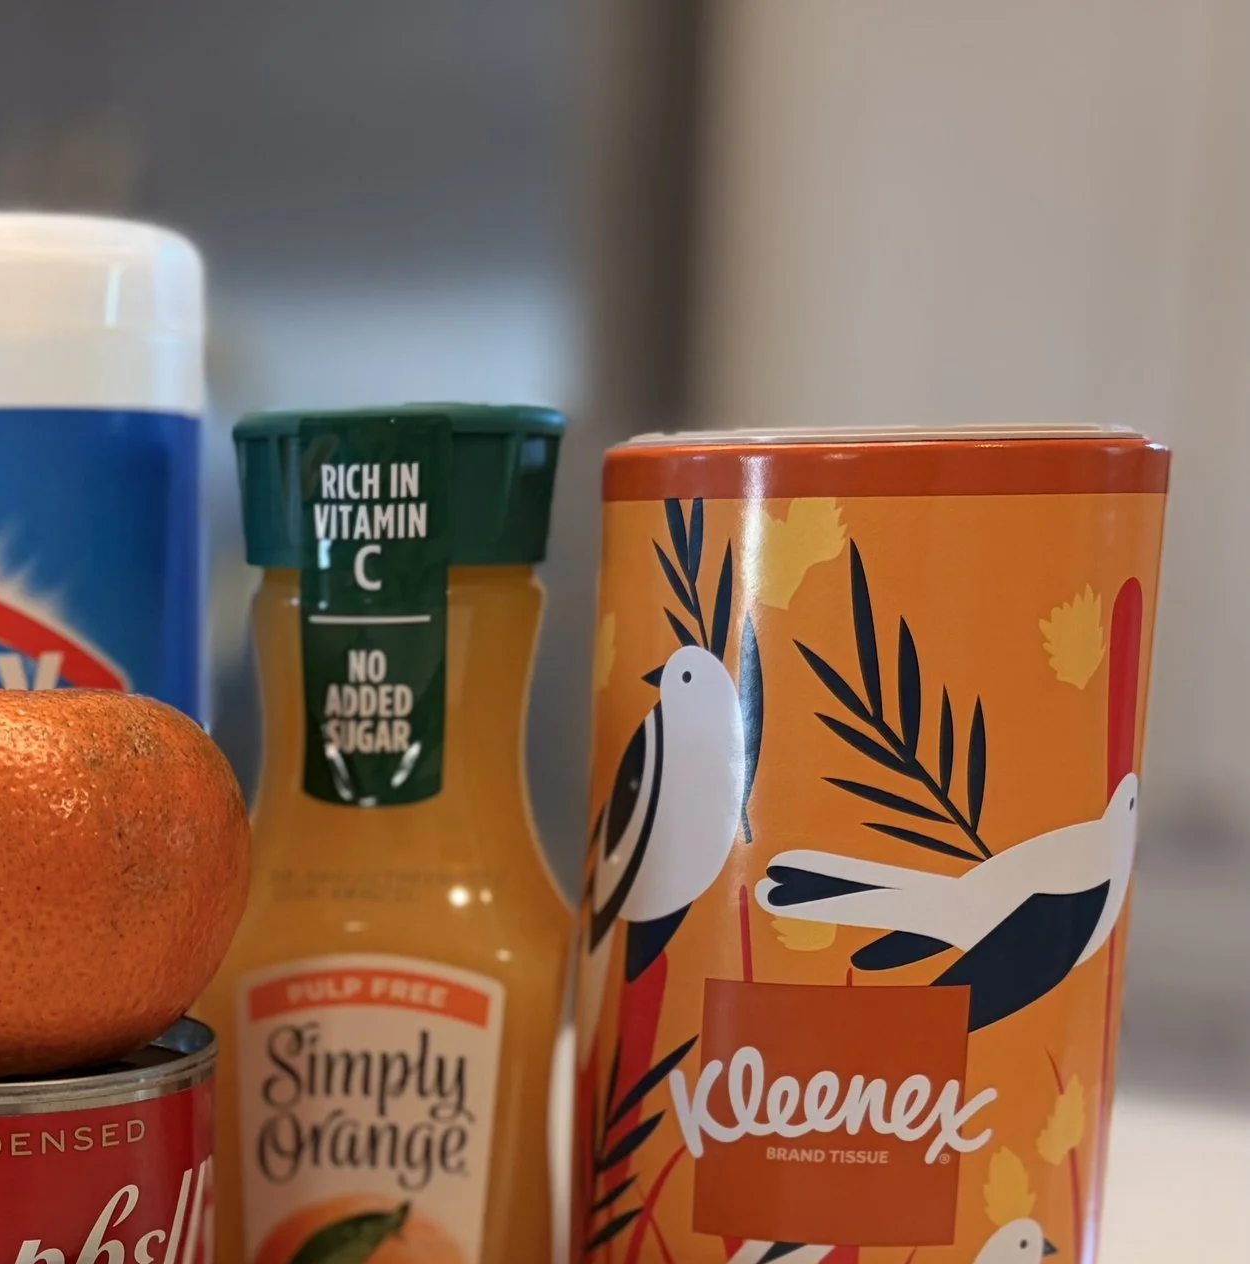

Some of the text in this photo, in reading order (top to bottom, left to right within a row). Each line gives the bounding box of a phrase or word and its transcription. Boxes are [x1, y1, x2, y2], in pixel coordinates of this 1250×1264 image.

[321, 462, 419, 499] RICH IN
[314, 503, 427, 540] VITAMIN
[354, 545, 382, 590] C
[348, 650, 387, 683] NO
[325, 684, 413, 717] ADDED
[325, 720, 411, 754] SUGAR
[286, 977, 451, 1008] PULP FREE
[261, 1021, 468, 1121] Simply
[668, 1046, 998, 1165] Kleenex
[257, 1108, 475, 1191] Orange
[765, 1147, 889, 1165] BRAND TISSUE
